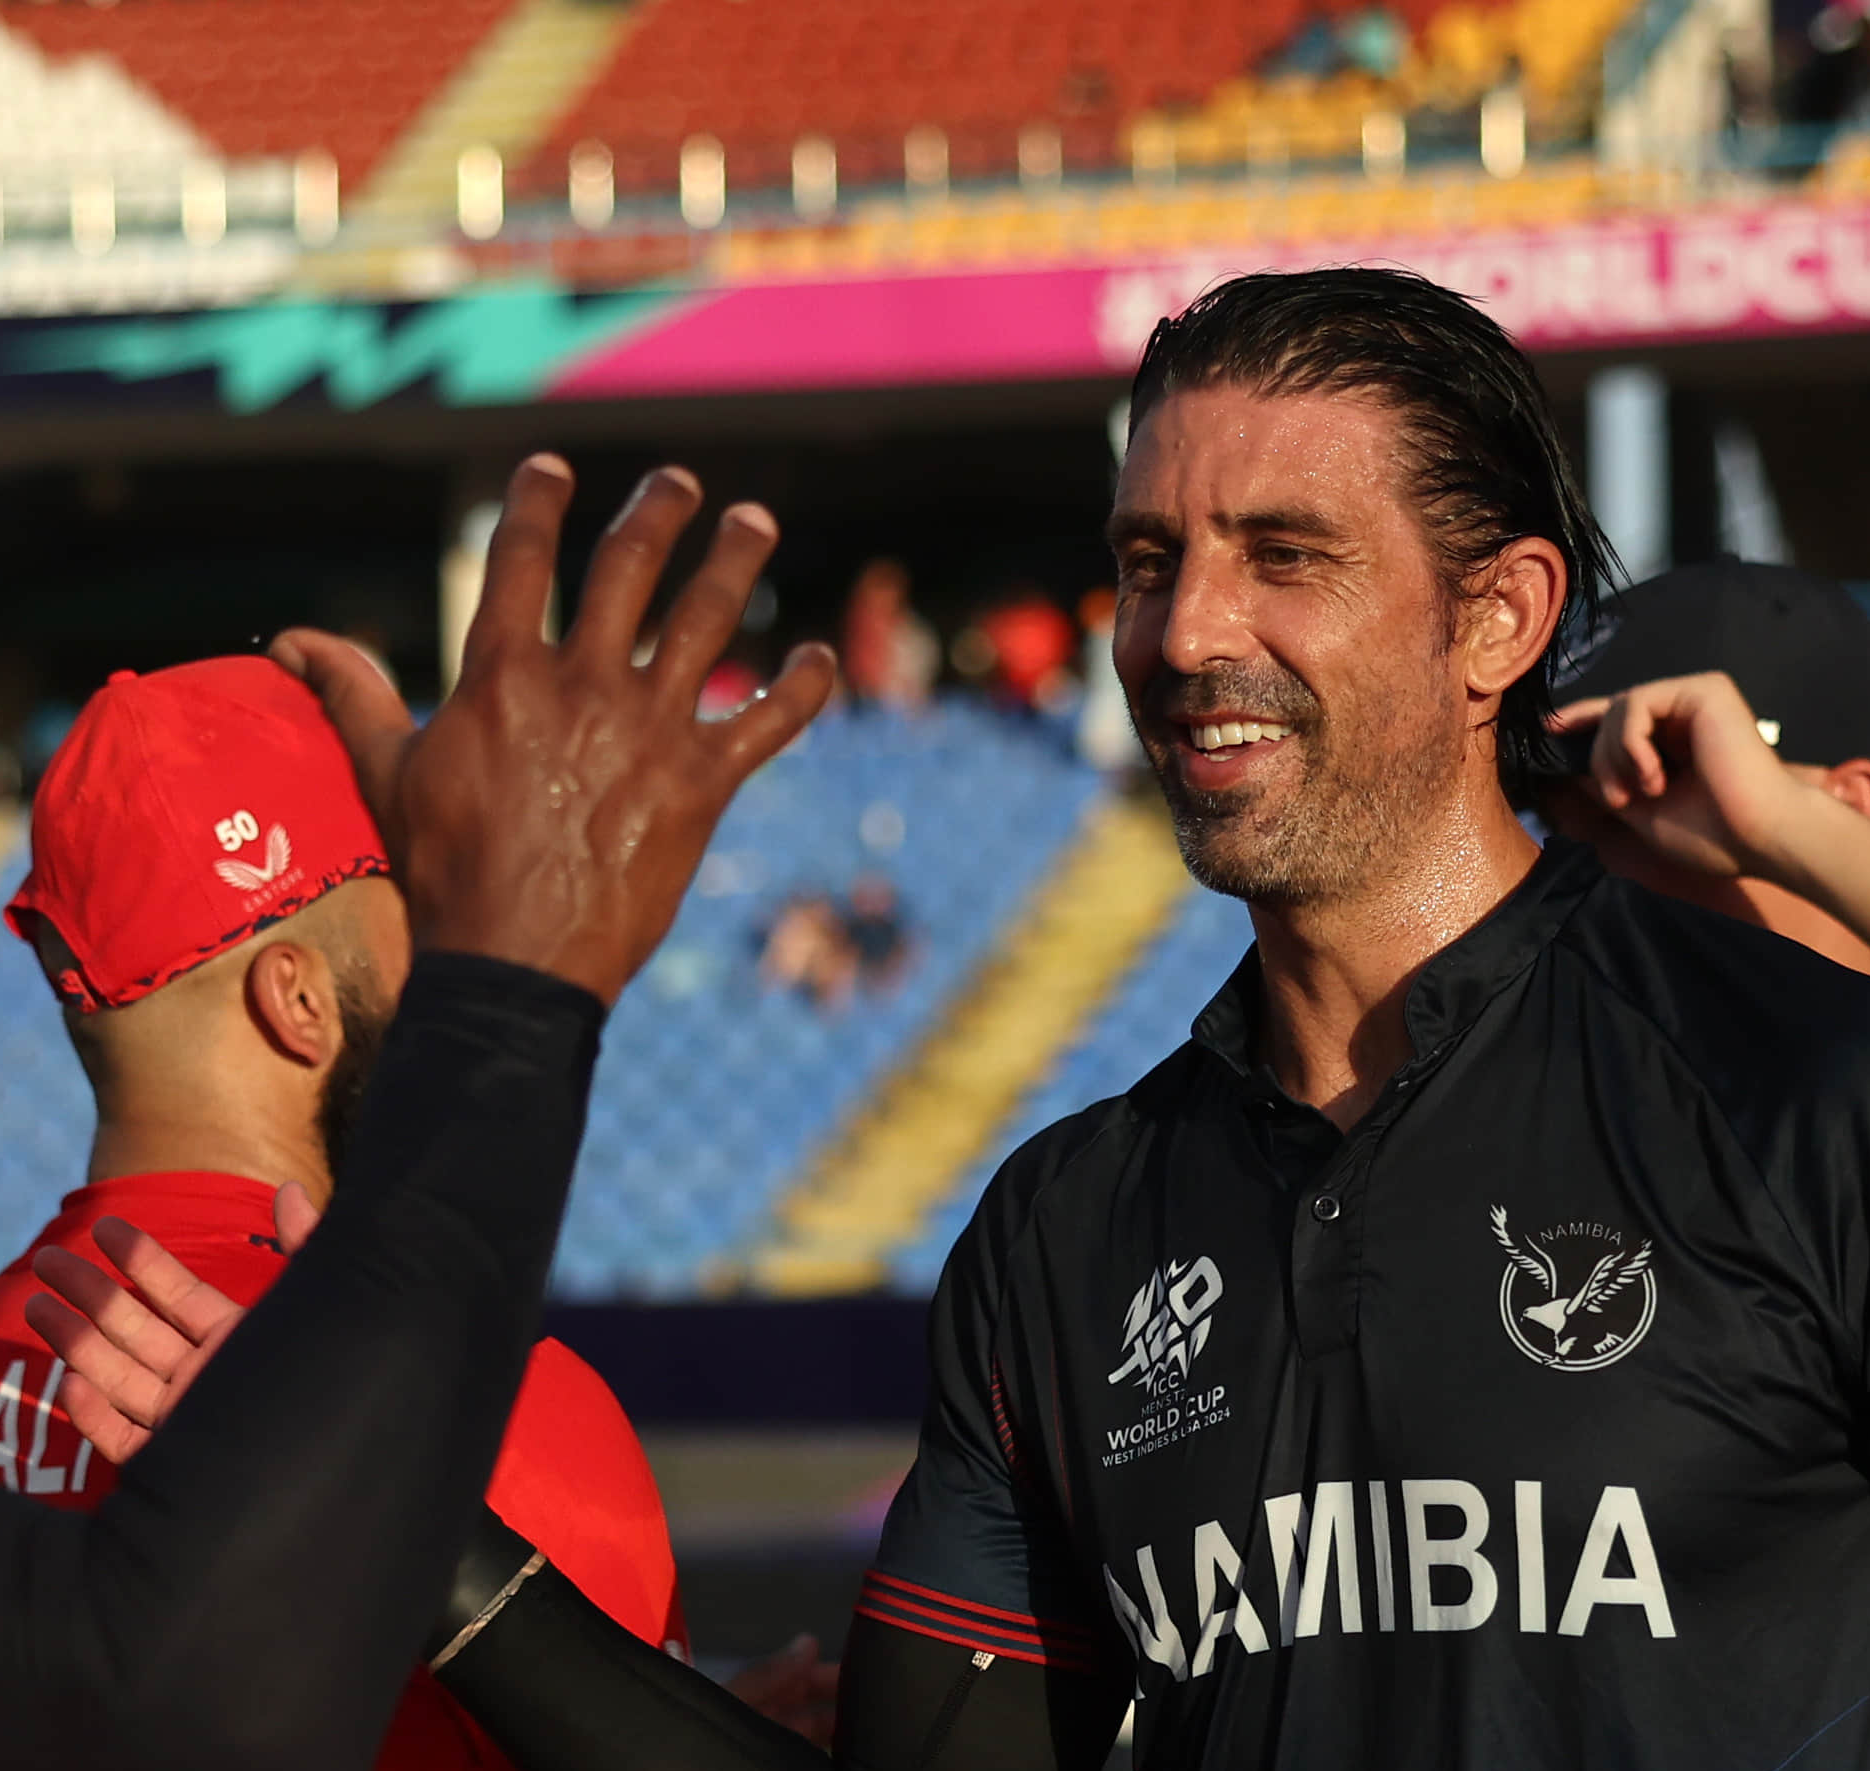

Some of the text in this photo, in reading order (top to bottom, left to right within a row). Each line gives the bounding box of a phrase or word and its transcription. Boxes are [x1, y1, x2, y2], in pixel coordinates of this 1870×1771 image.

[214, 809, 259, 852] 50
[1540, 1221, 1623, 1246] NAMIBIA
[1153, 1371, 1180, 1398] ICC
[1107, 1385, 1225, 1451] WORLD CUP
[1102, 1449, 1134, 1468] WEST
[1137, 1433, 1169, 1458] INDIES
[1103, 1479, 1677, 1700] NAMIBIA
